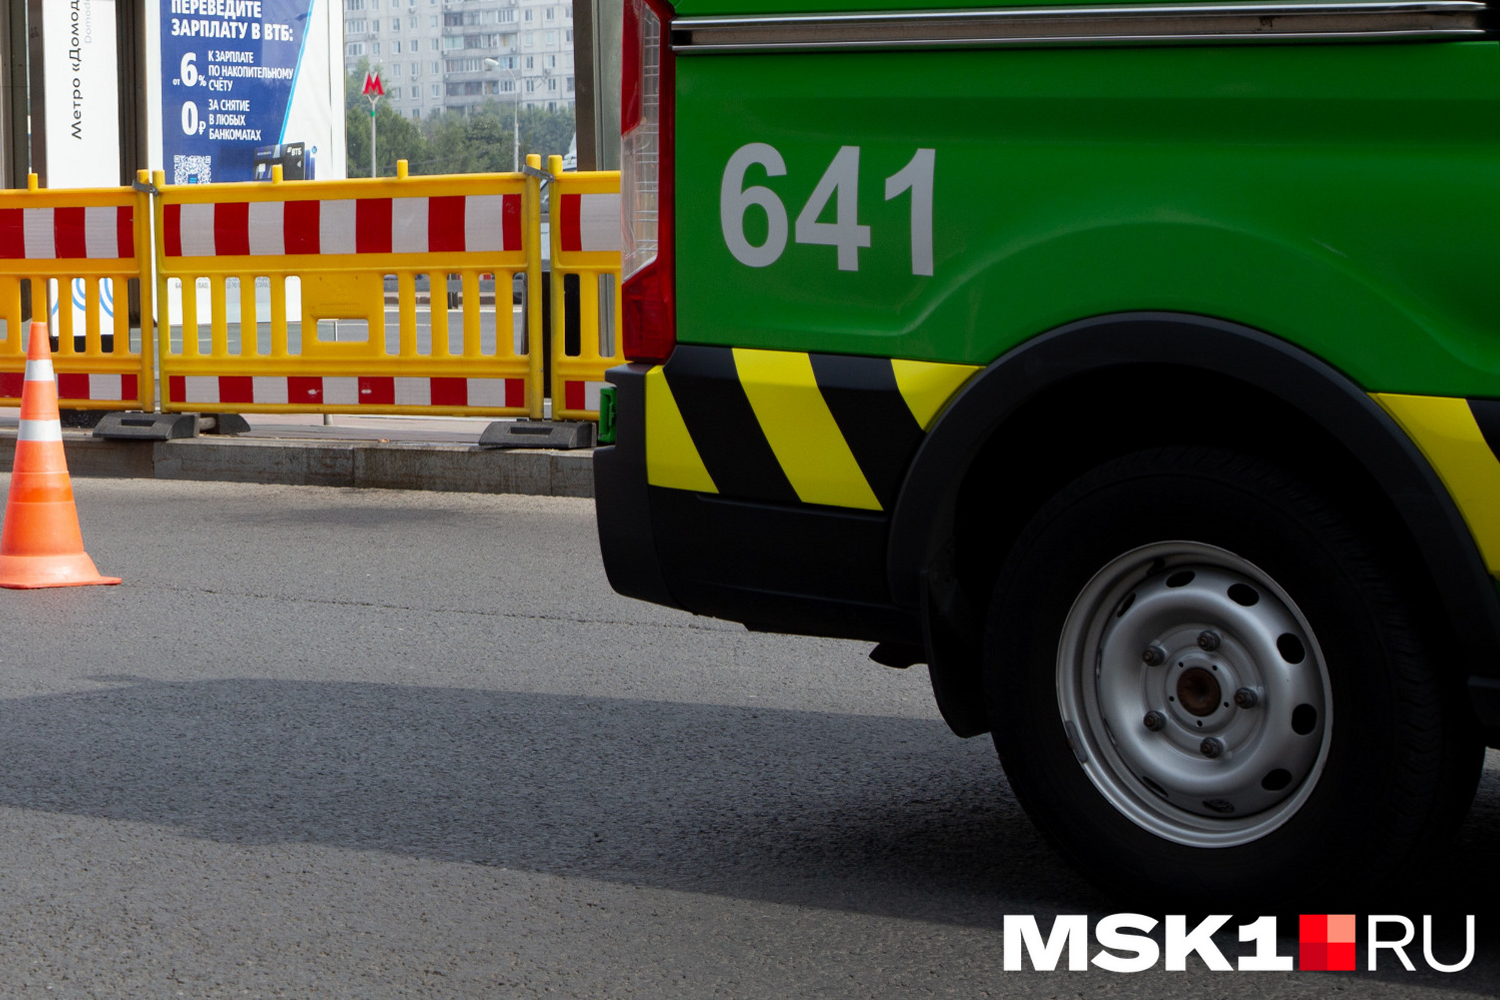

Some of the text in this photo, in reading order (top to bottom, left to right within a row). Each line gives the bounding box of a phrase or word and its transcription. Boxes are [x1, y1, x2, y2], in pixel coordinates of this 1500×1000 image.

[171, 18, 293, 41] ЗАРПЛАТУ В ВТБ:
[208, 50, 254, 63] К ЗАРПЛАТЕ
[208, 65, 294, 80] ПО НАКОПИТЕЛЬНОМУ
[71, 78, 83, 140] Метро
[208, 99, 250, 112] ЗА СНЯТИЕ
[209, 114, 246, 126] В ЛЮБЫХ
[209, 128, 261, 141] БАНКОМАТАХ
[720, 142, 936, 277] 641
